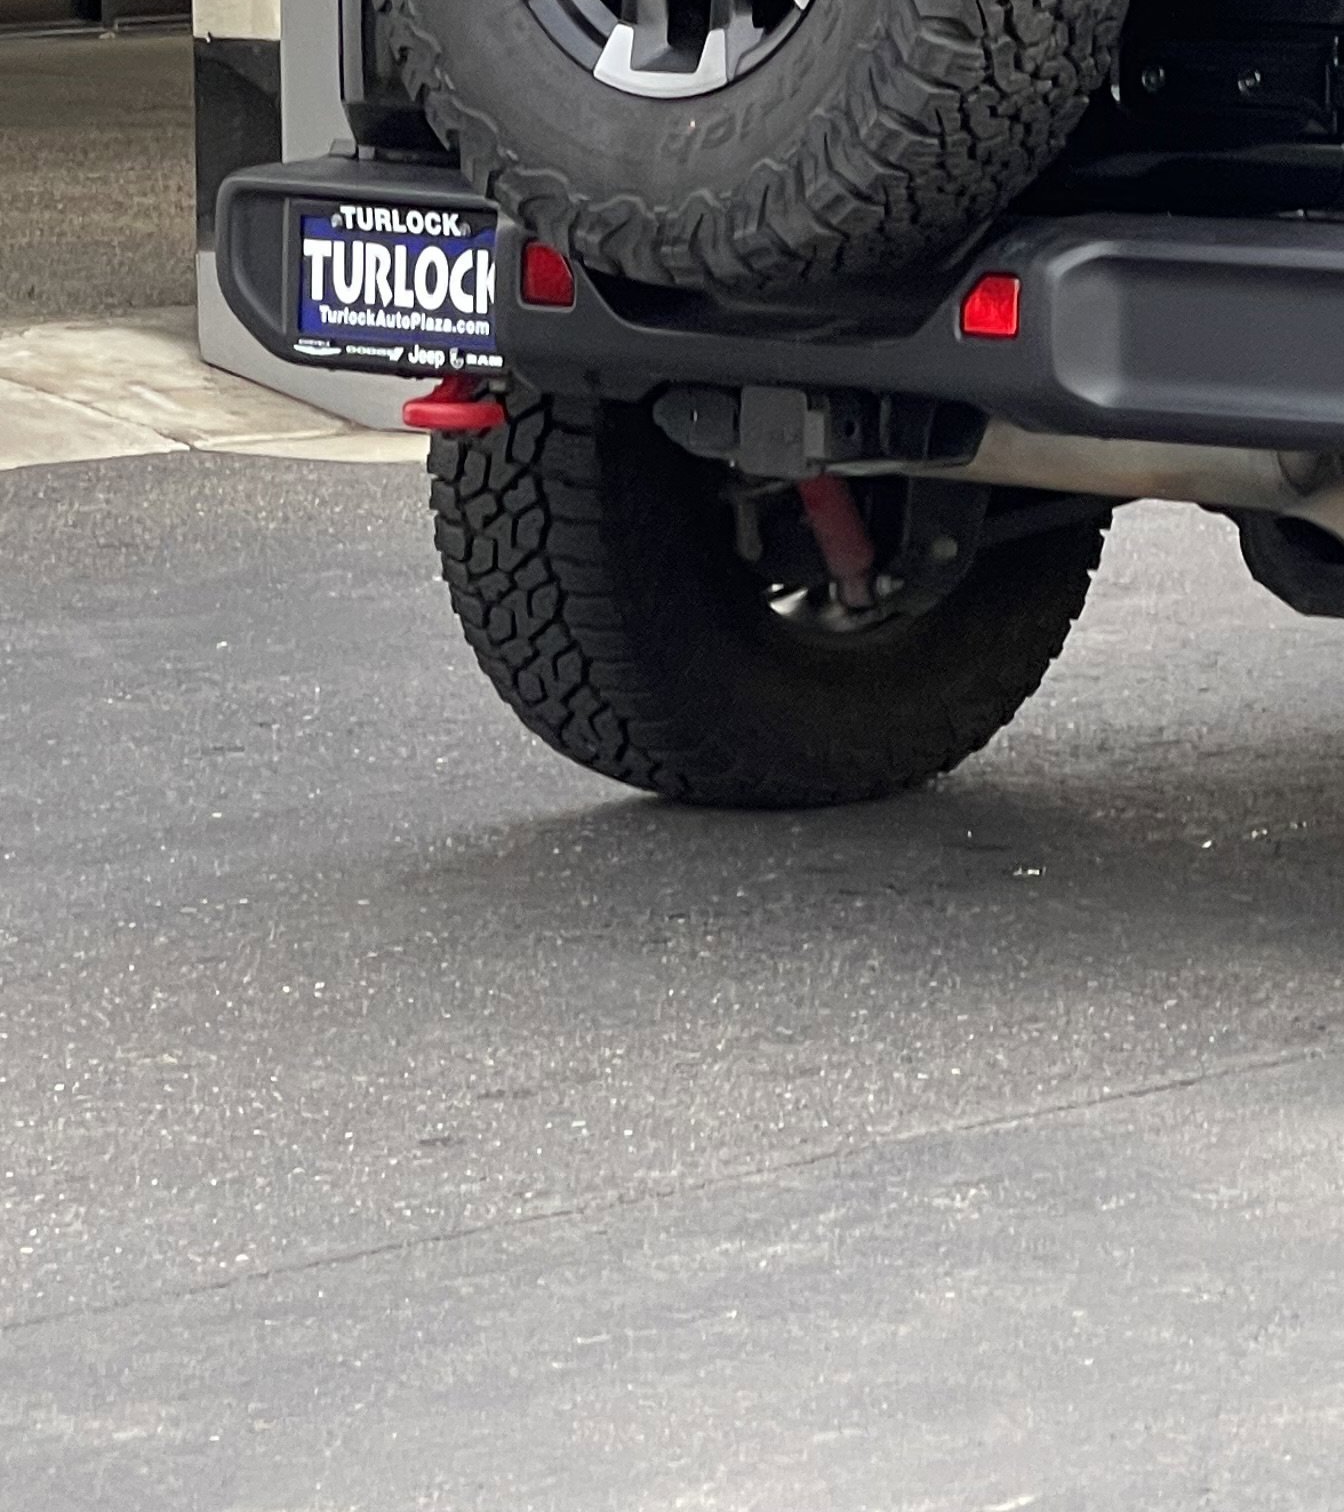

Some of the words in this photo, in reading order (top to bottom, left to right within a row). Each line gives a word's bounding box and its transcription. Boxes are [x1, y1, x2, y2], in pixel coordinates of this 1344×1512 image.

[339, 204, 461, 237] TURLOCK
[303, 238, 496, 315] TURLOCK
[318, 304, 491, 336] TurlockAutoPlaza.com
[408, 343, 446, 369] Jeep
